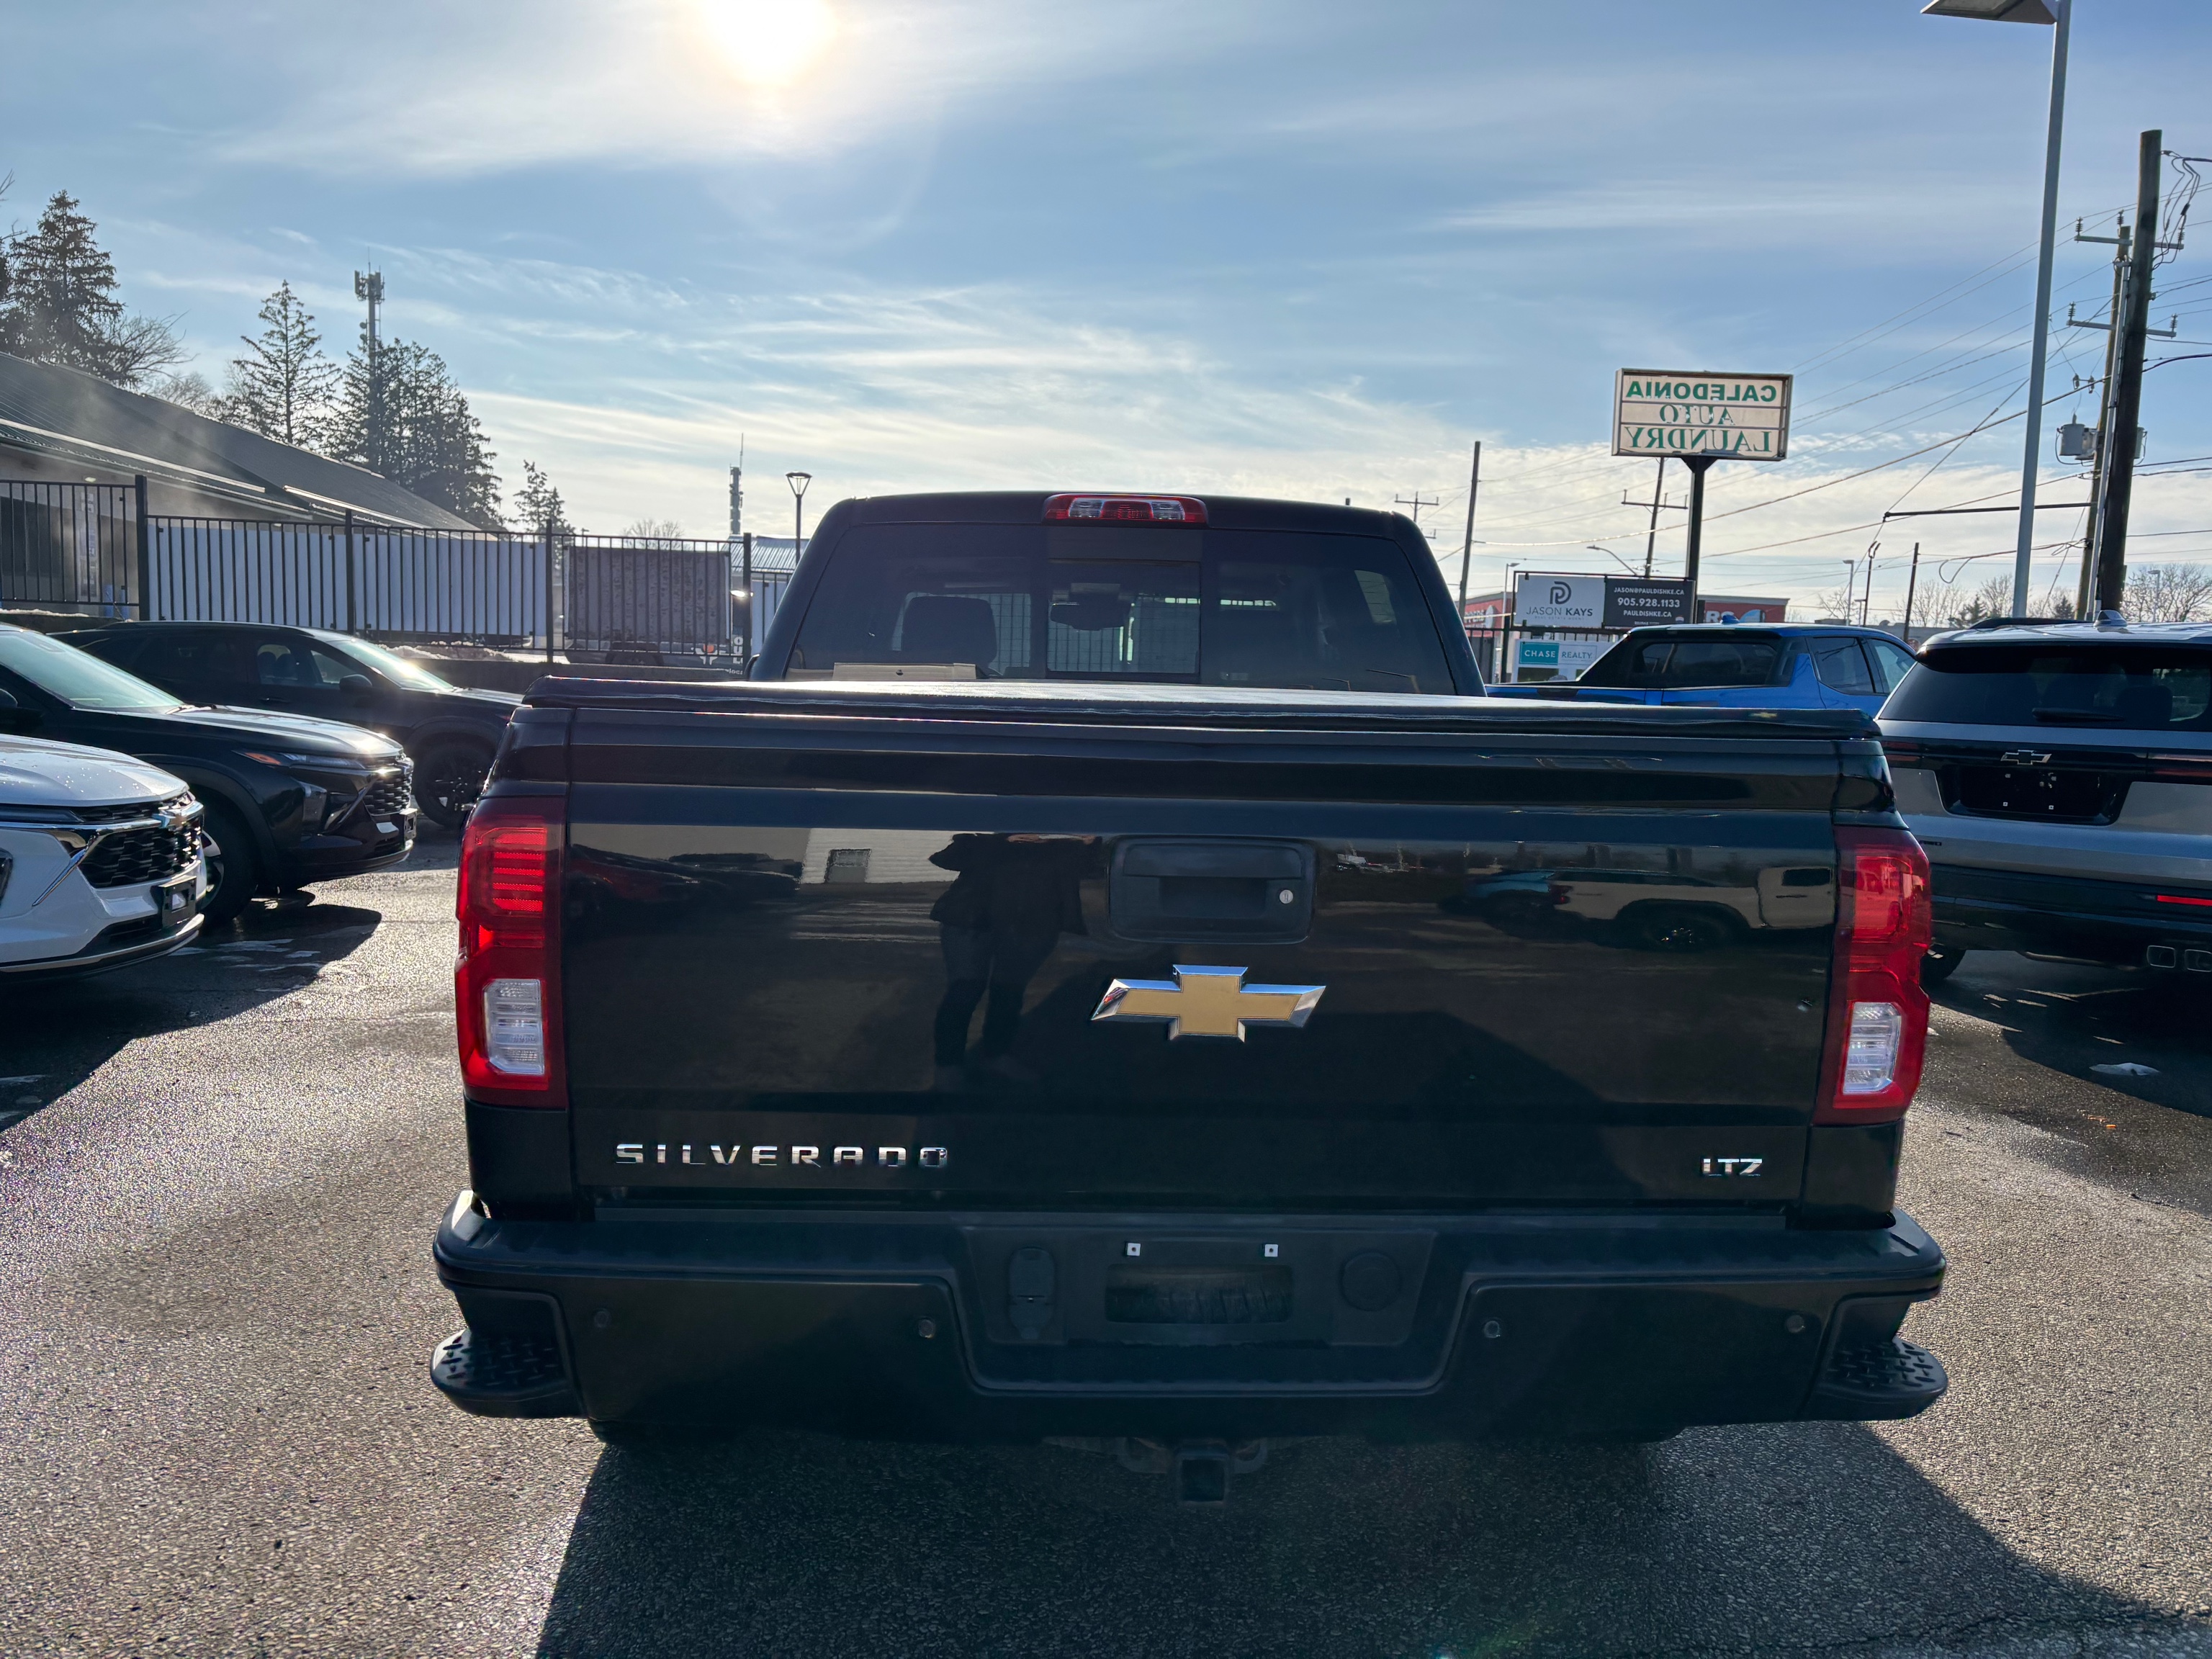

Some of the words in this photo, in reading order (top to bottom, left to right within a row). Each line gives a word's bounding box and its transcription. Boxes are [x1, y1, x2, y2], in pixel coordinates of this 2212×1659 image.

[1617, 597, 1680, 608] 905.928.1133
[1526, 606, 1562, 616] JASON
[1565, 608, 1593, 616] KAYS
[1524, 649, 1556, 658] CHASE
[615, 1143, 948, 1168] SILVERADO
[1701, 1158, 1763, 1177] LTZ
